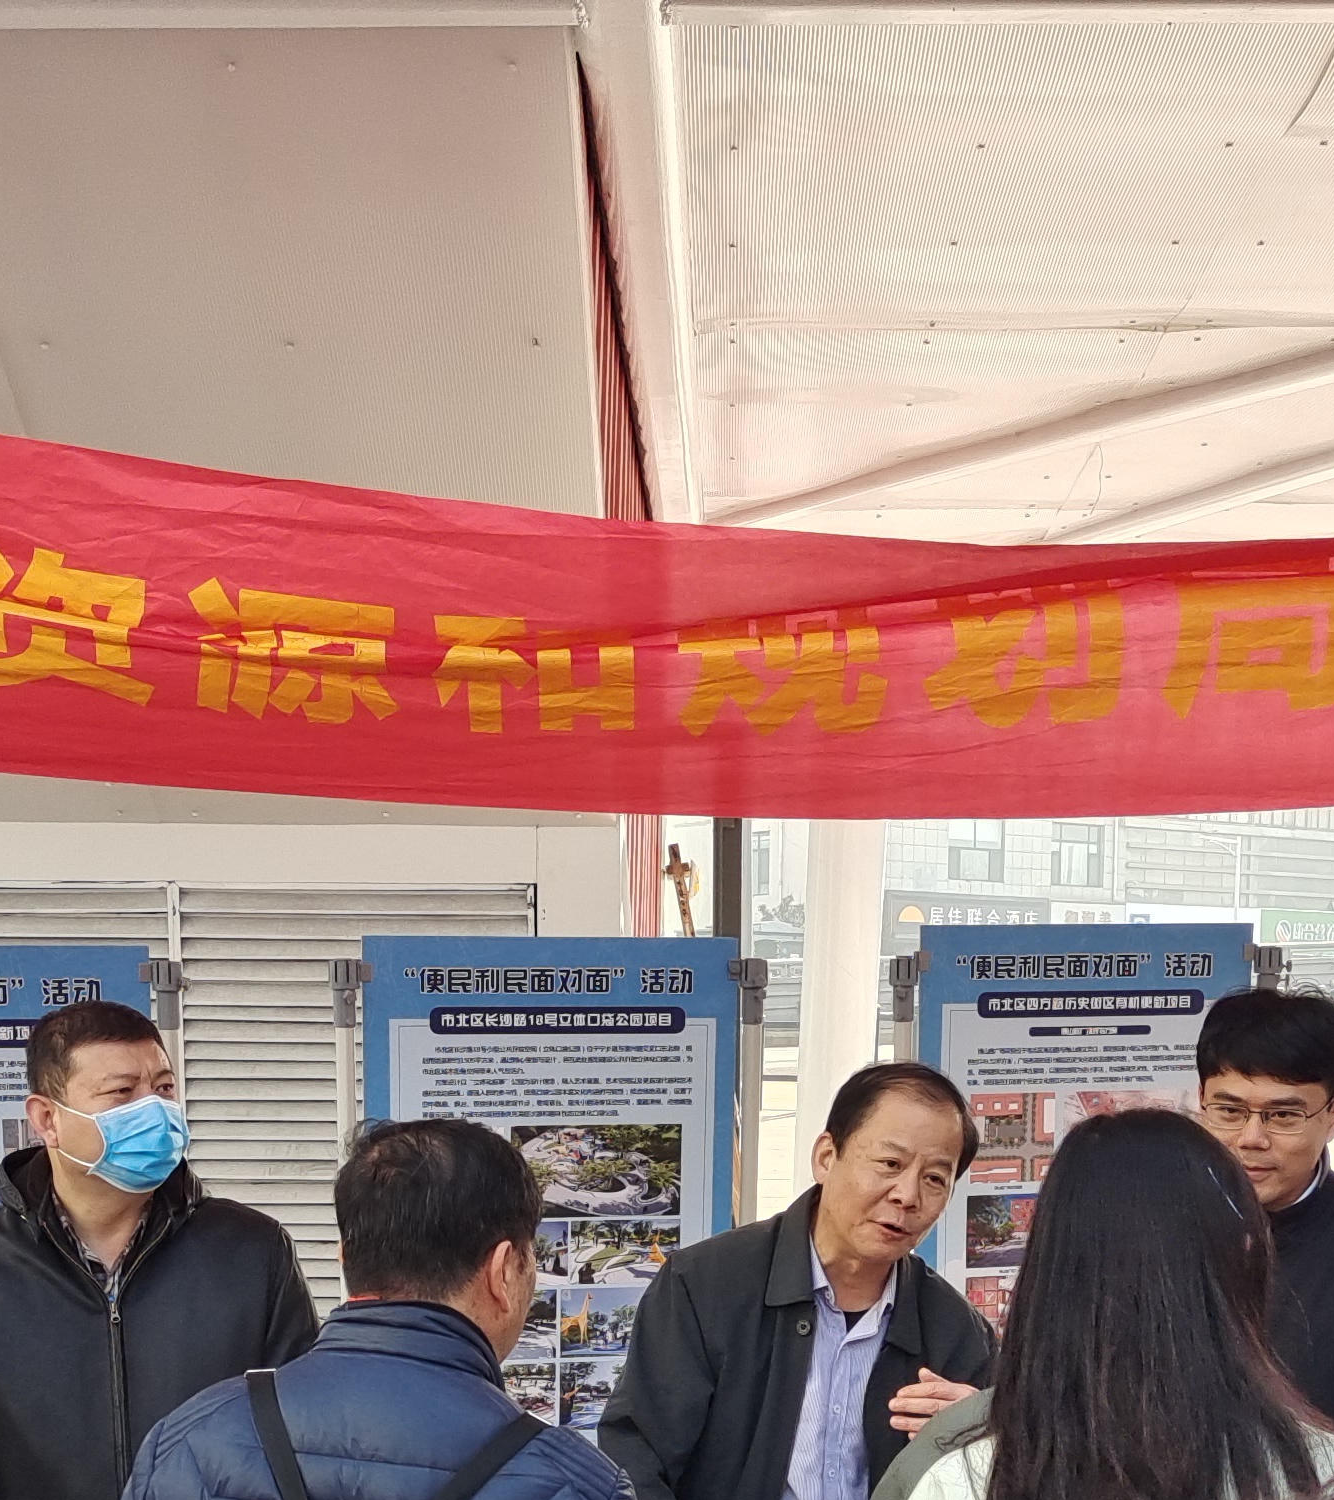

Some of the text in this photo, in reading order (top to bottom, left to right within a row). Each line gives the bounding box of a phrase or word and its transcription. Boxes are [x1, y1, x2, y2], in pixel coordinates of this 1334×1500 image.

[1164, 953, 1212, 978] 活动
[41, 977, 101, 1005] 活动
[640, 968, 694, 994] 活动
